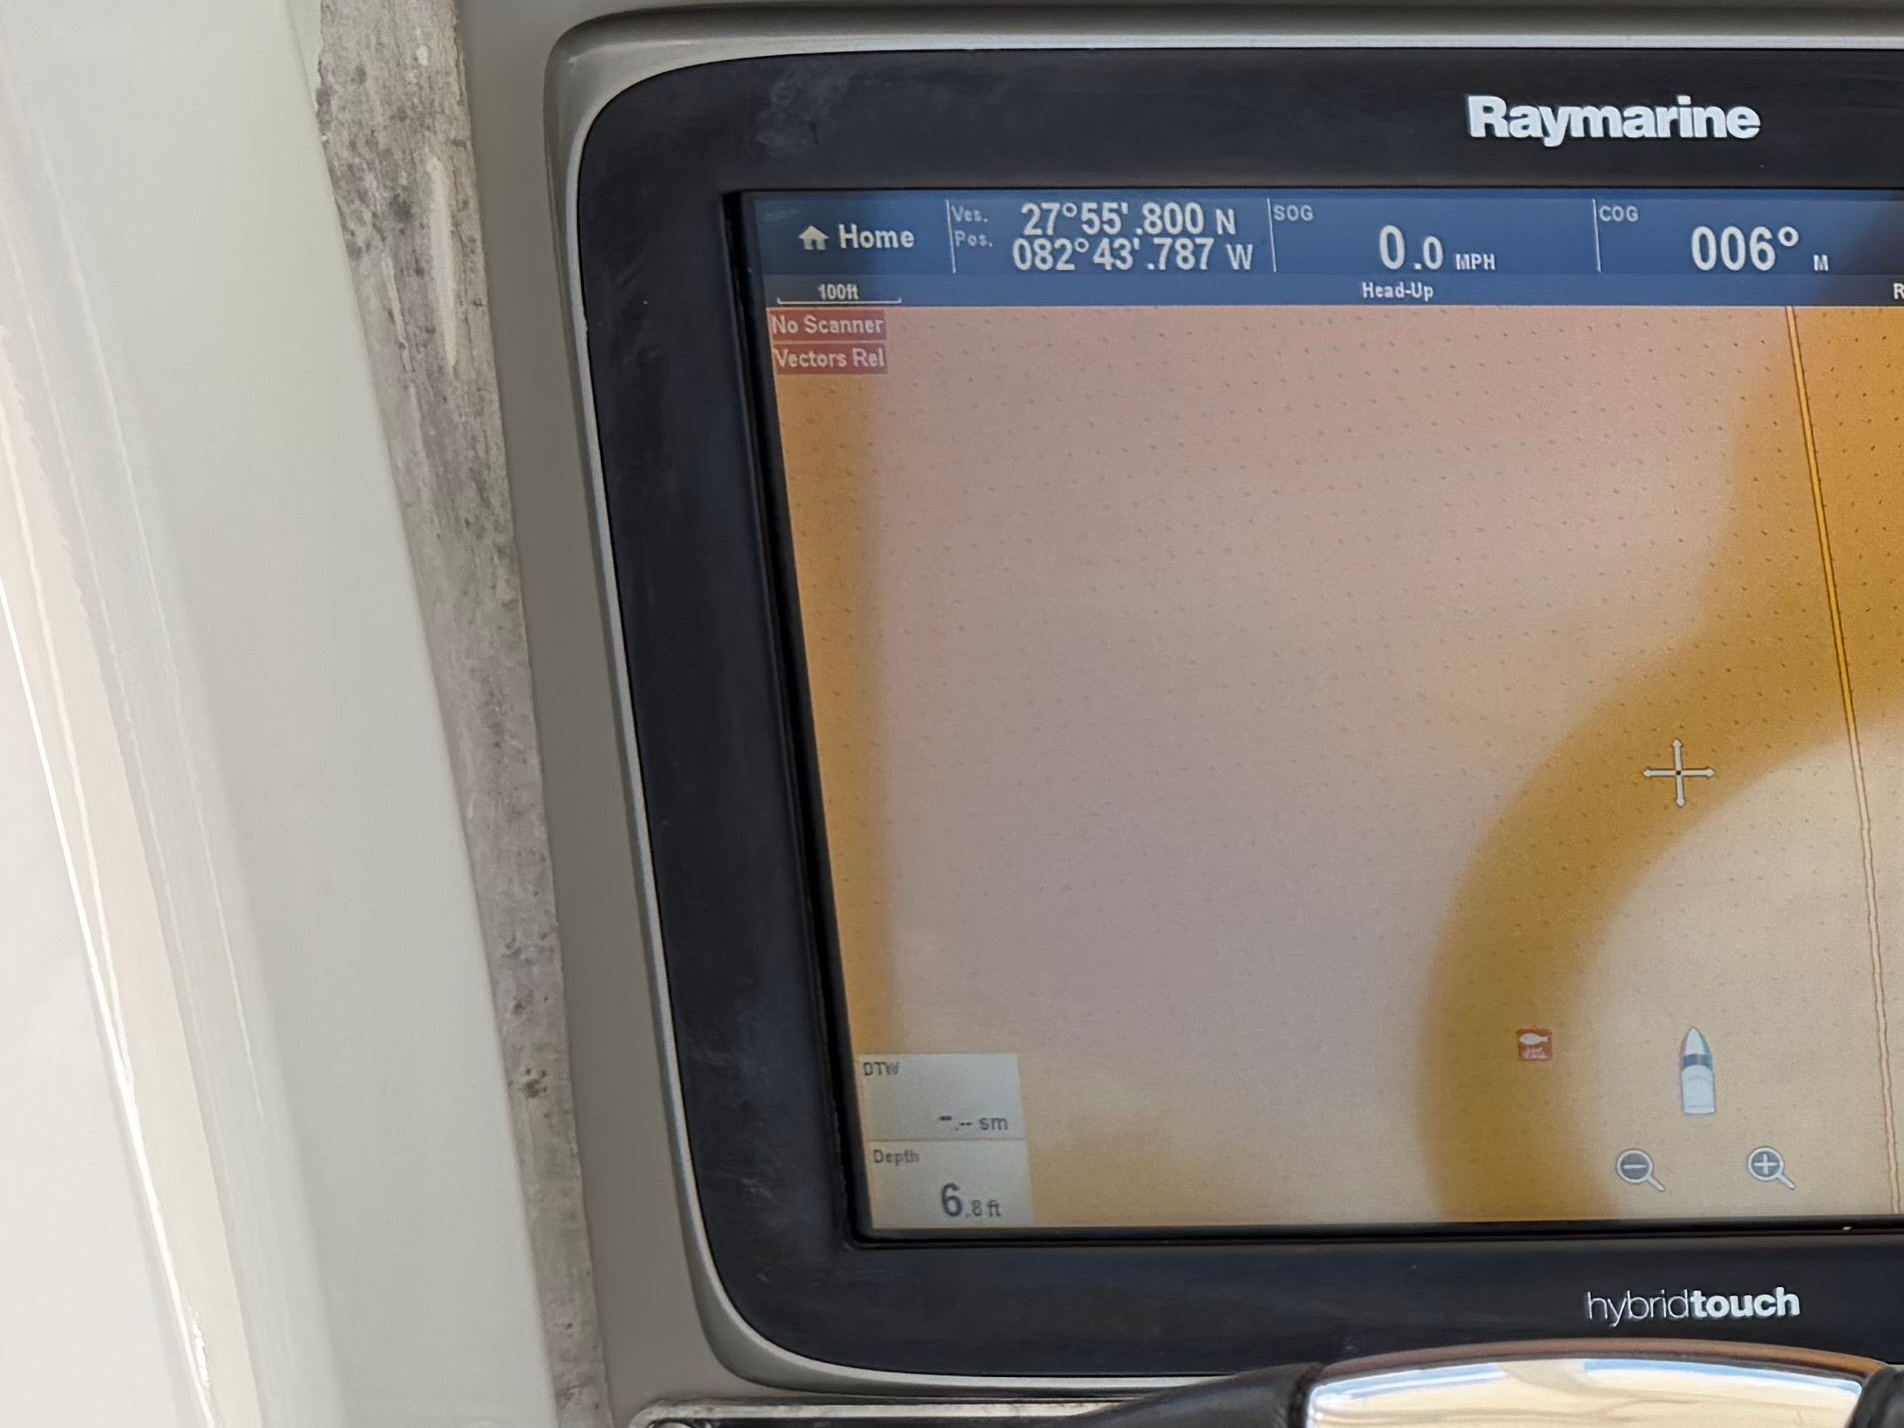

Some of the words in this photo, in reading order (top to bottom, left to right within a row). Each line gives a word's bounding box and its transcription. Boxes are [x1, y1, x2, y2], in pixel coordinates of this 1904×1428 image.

[1467, 95, 1762, 147] Raymarine
[952, 206, 988, 223] Ves.
[1216, 209, 1236, 235] N
[1273, 204, 1313, 222] SOG
[1599, 204, 1639, 222] COG
[839, 224, 916, 251] Home
[954, 231, 993, 247] Pos.
[1379, 224, 1443, 271] 0.0
[1455, 253, 1496, 271] MPH
[1227, 245, 1253, 270] W
[1691, 225, 1799, 272] 006°
[1813, 254, 1829, 272] M
[817, 284, 860, 301] 100ft
[1362, 282, 1435, 302] Head-Up
[772, 315, 799, 335] No
[805, 314, 885, 335] Scanner
[774, 348, 847, 368] Vectors
[852, 348, 886, 368] Rel
[979, 1116, 1009, 1131] sm
[873, 1149, 920, 1166] Depth
[940, 1183, 984, 1218] 6.8
[988, 1200, 1002, 1218] ft
[1585, 1286, 1801, 1328] hybridtouch
